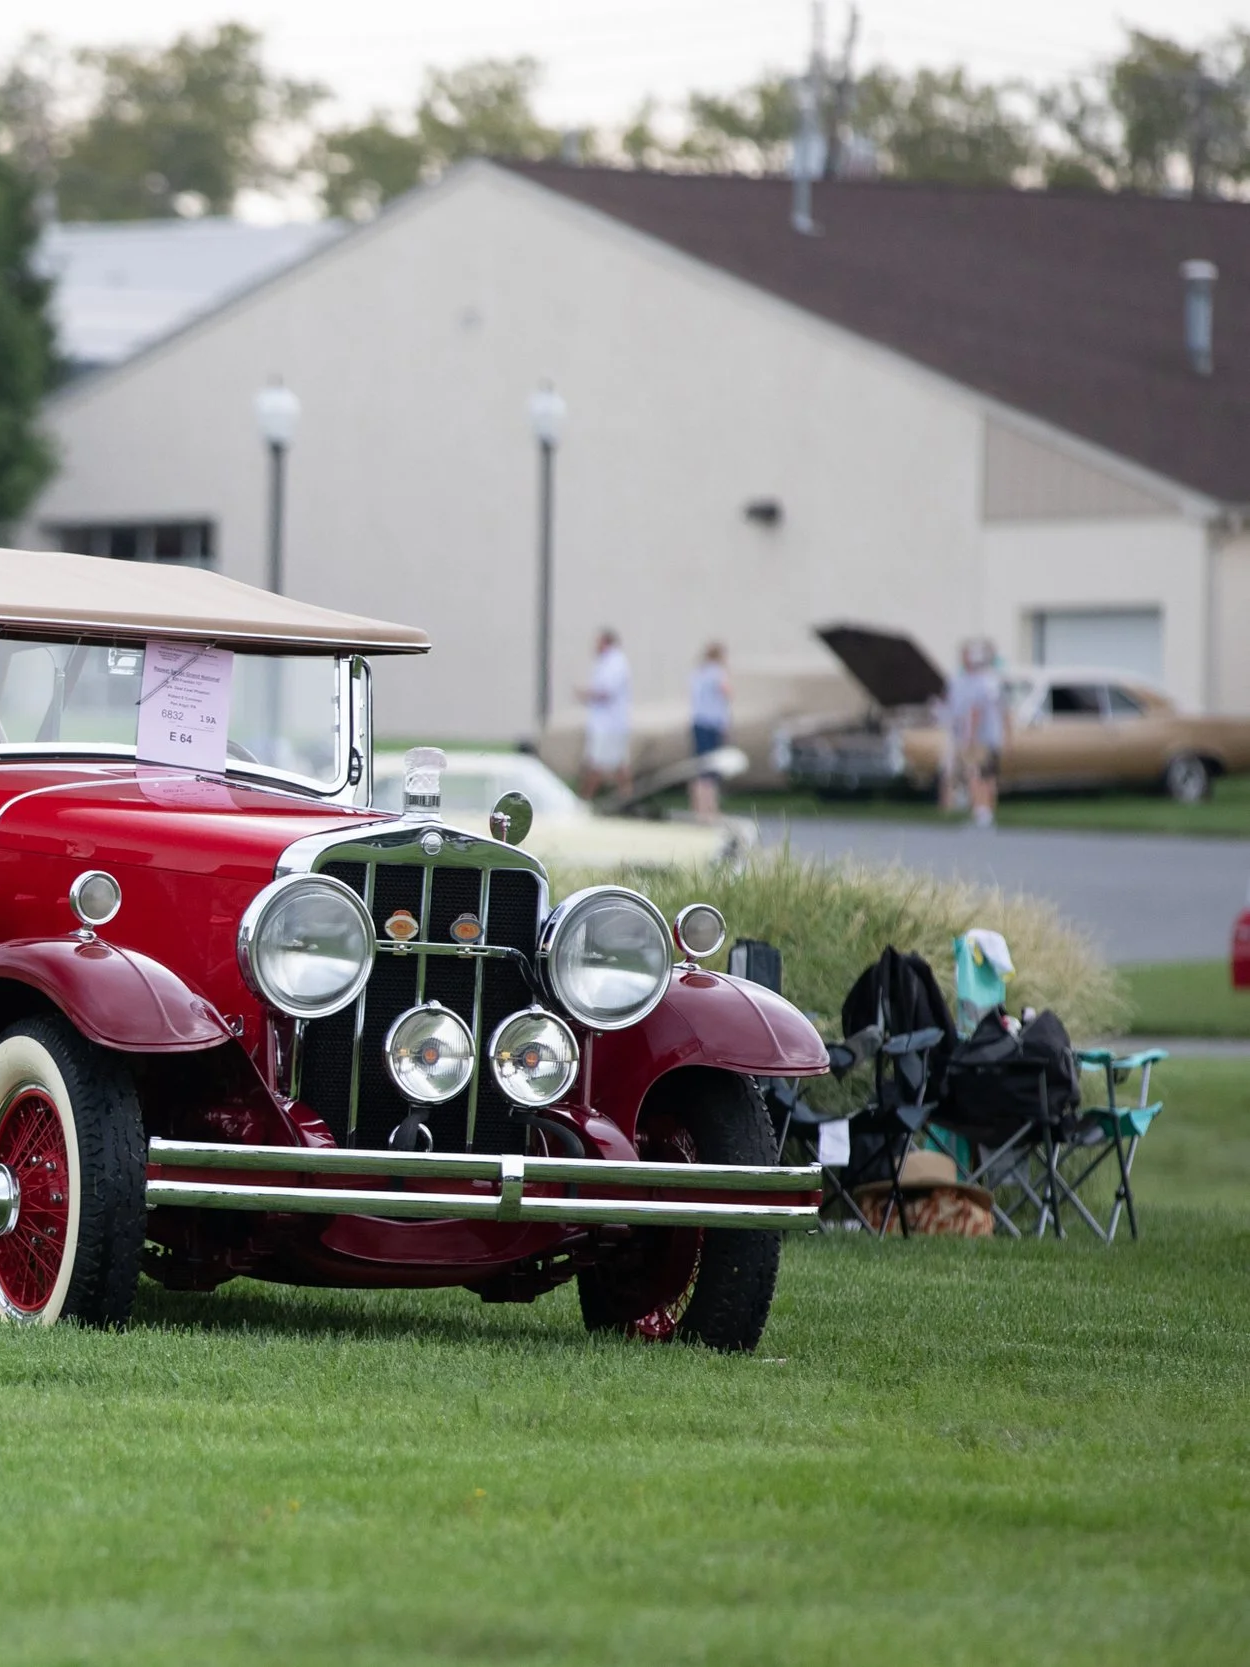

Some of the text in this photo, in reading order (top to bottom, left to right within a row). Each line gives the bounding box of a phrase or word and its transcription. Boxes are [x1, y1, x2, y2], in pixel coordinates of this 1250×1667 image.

[161, 708, 184, 721] 6832
[200, 714, 217, 725] 19A
[170, 731, 192, 744] E 64
